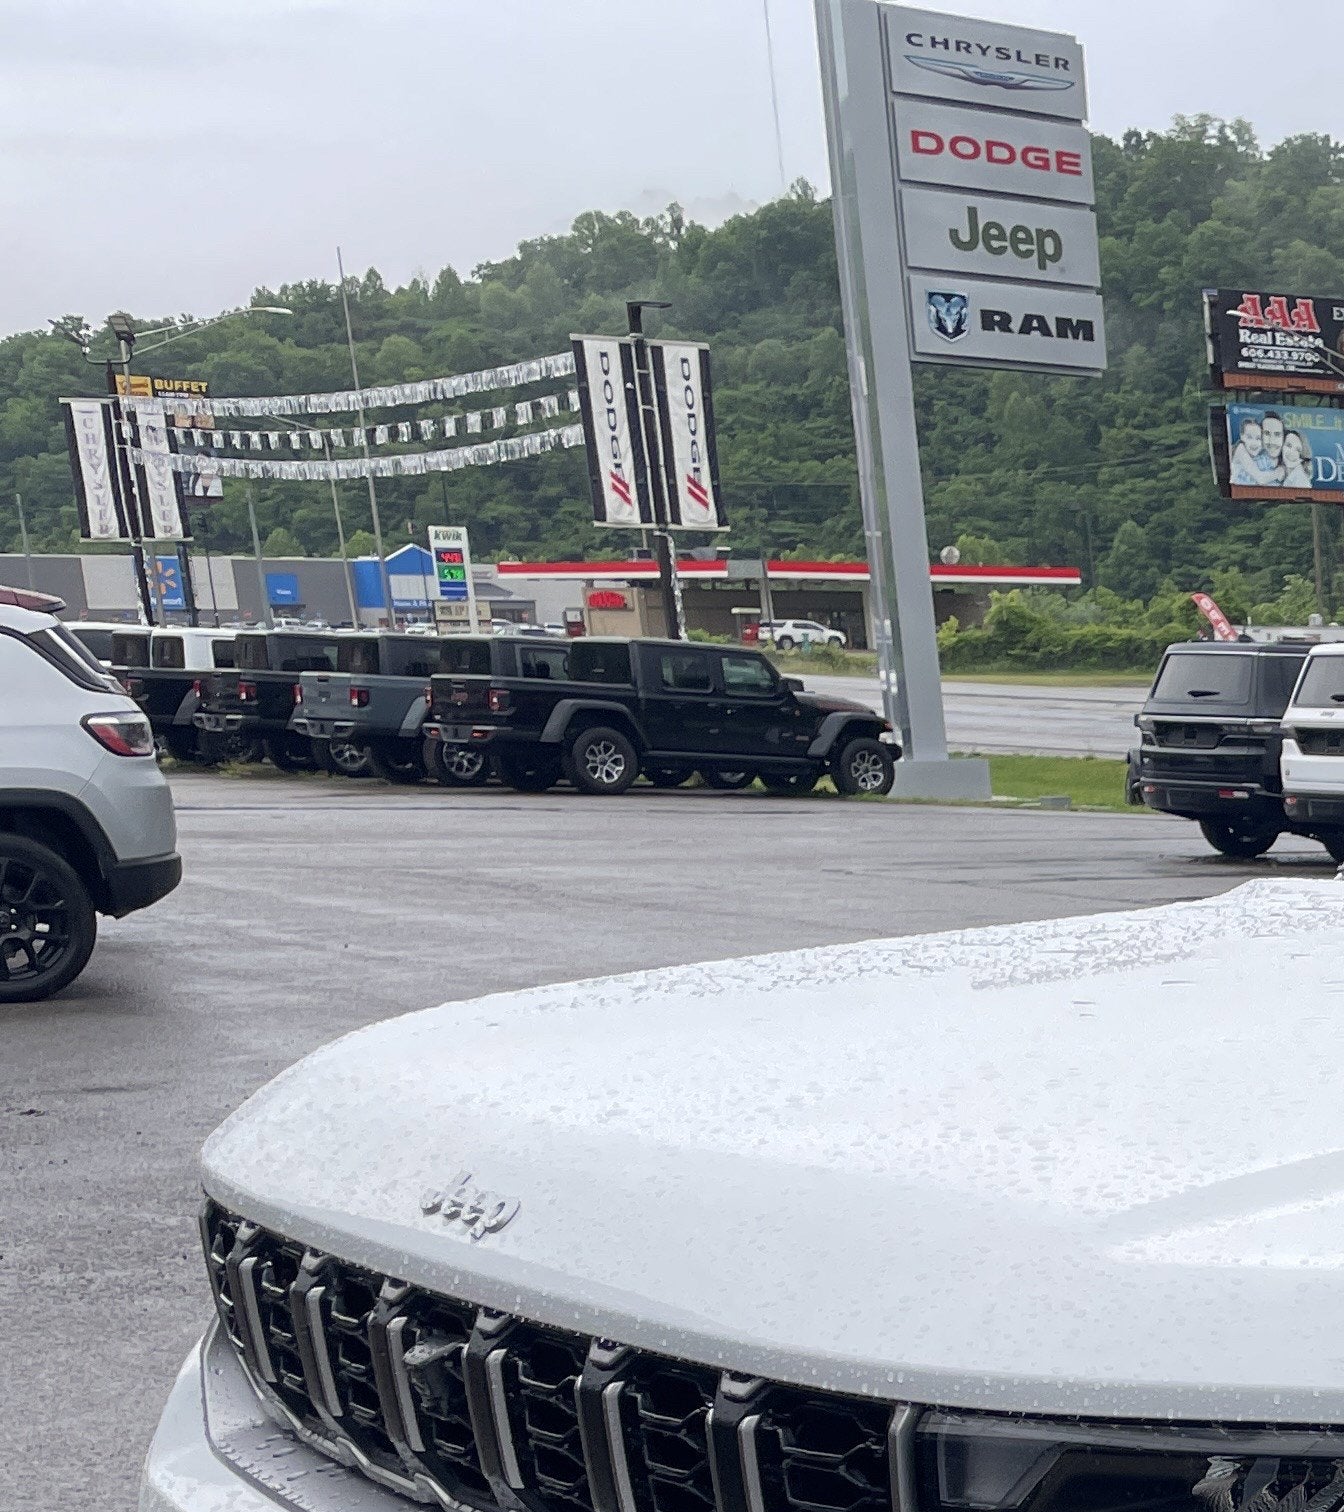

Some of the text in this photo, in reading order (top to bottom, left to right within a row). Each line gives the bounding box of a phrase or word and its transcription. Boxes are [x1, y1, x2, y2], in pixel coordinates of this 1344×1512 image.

[905, 33, 1070, 71] CHRYSLER
[911, 130, 1082, 176] DODGE
[949, 206, 1062, 270] Jeep
[980, 309, 1095, 341] RAM
[1237, 293, 1321, 333] AAA
[1239, 329, 1273, 345] Real
[154, 379, 208, 393] BUFFET
[420, 1169, 522, 1241] Jeep
